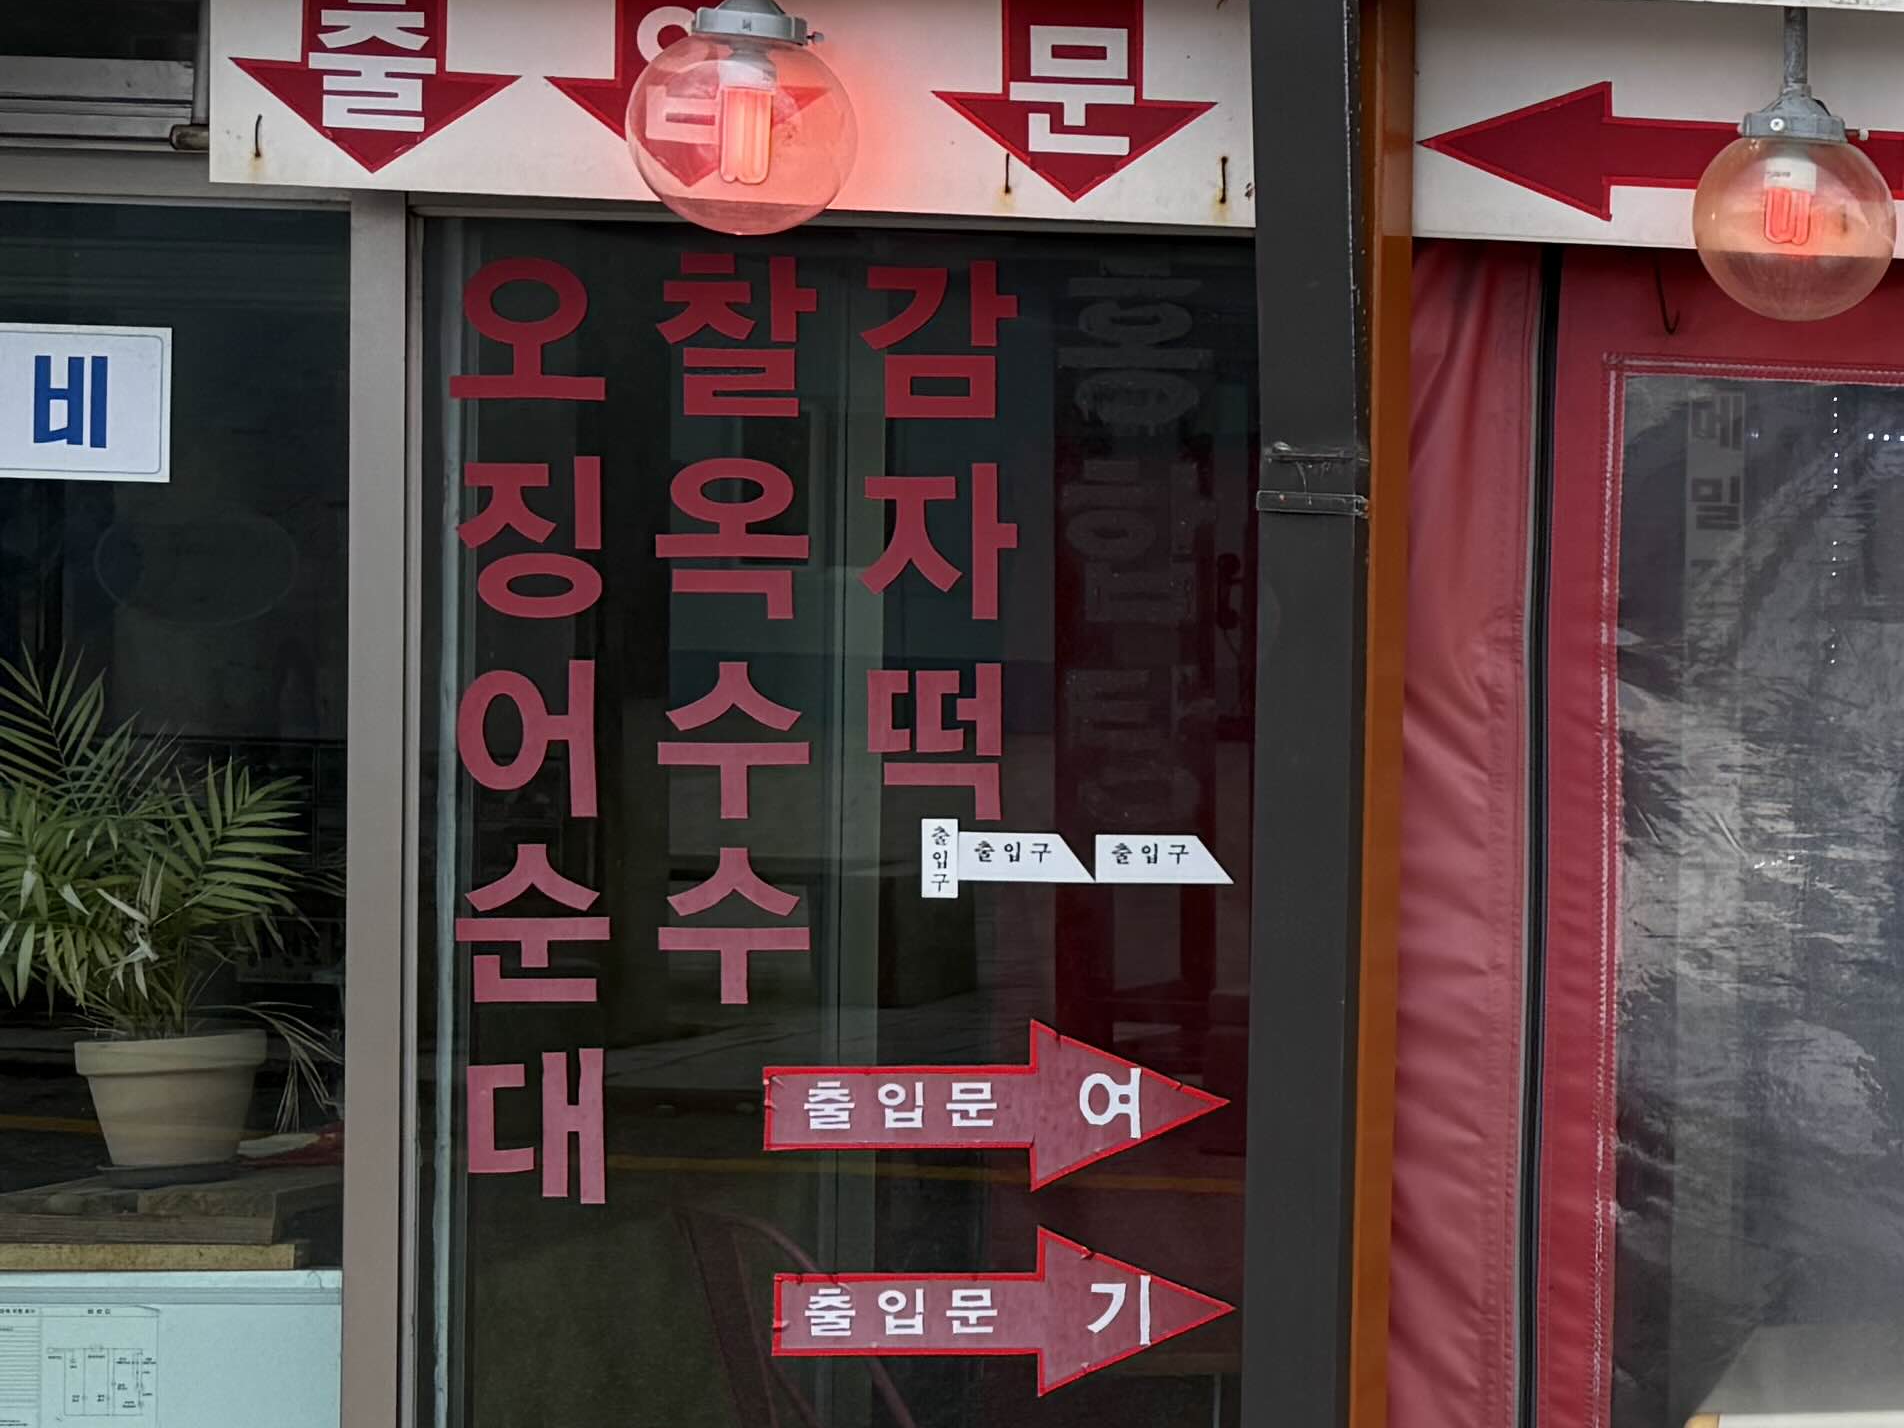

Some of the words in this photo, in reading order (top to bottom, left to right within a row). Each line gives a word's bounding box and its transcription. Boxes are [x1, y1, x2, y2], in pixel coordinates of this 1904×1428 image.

[860, 261, 1019, 821] 감자떡
[655, 252, 818, 1005] 찰옥수수
[448, 258, 610, 1204] 오징어순대
[930, 825, 951, 893] 출입구
[974, 839, 1052, 864] 출입구
[1111, 842, 1189, 866] 출입구
[803, 1079, 998, 1131] 출입문
[1079, 1066, 1143, 1140] 여
[804, 1286, 998, 1338] 출입문
[1087, 1274, 1152, 1346] 기
